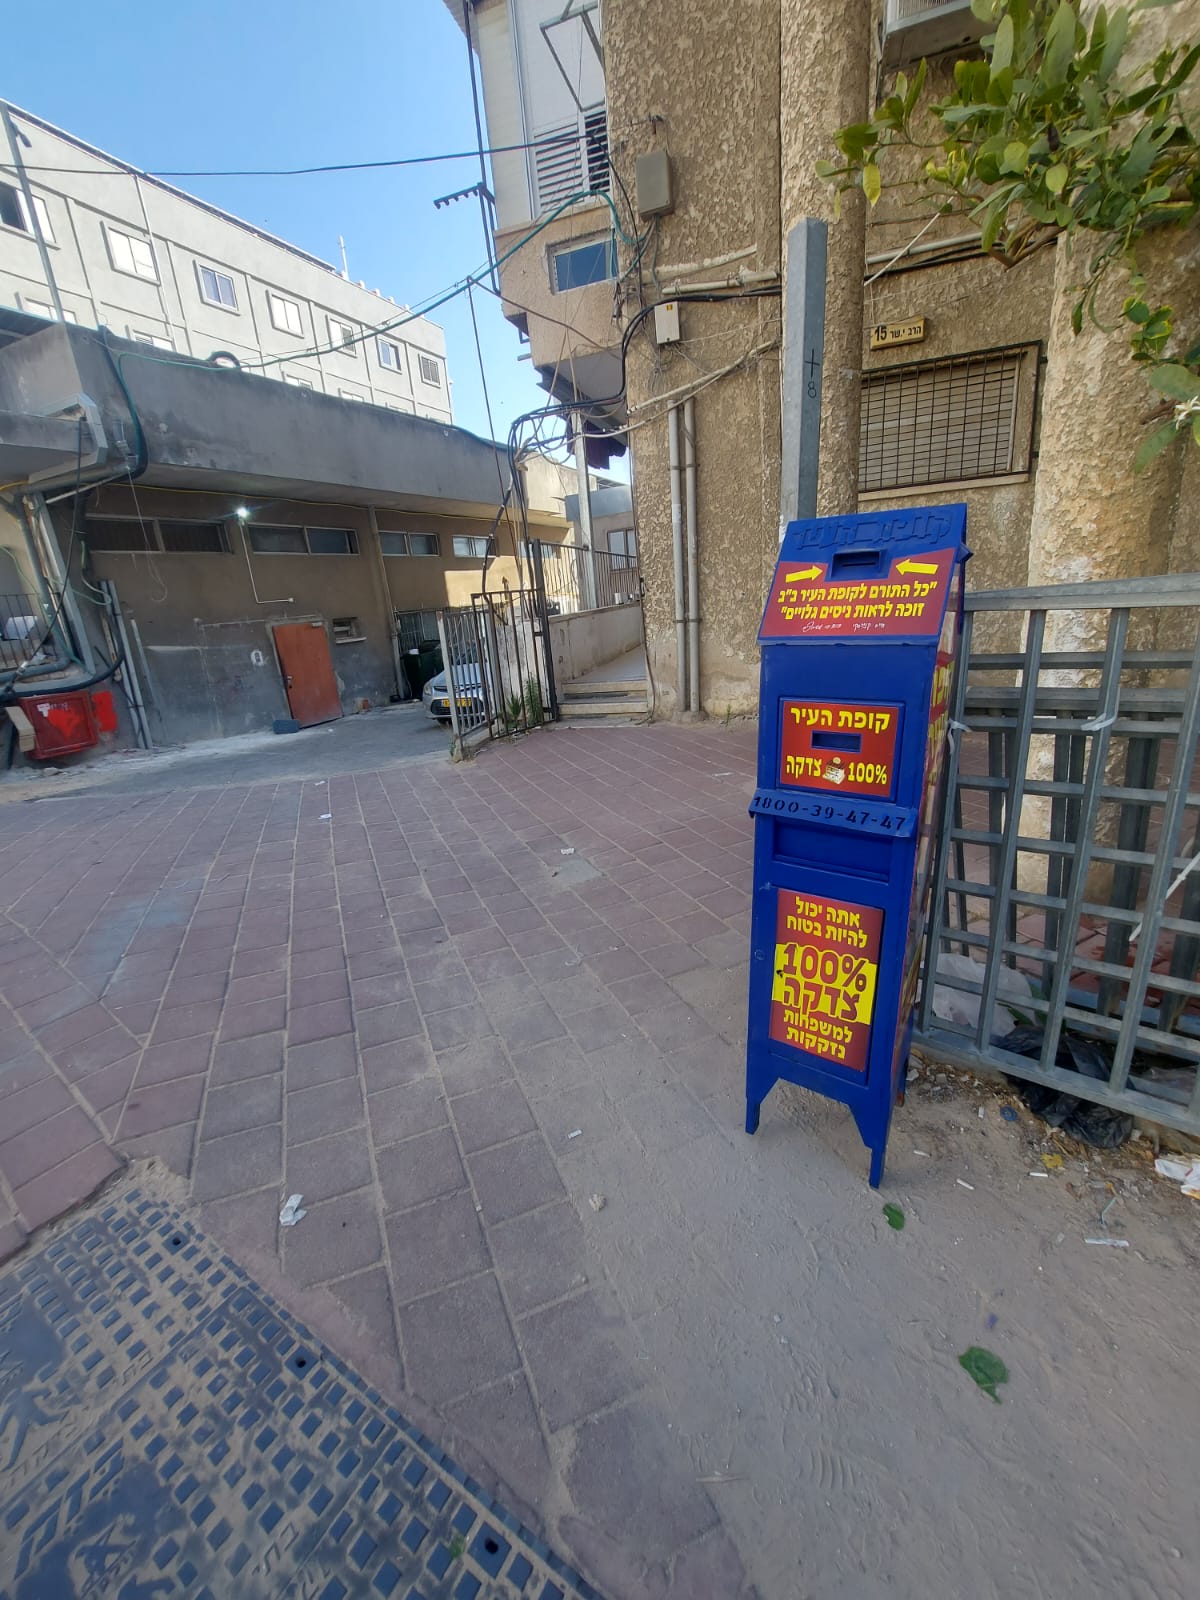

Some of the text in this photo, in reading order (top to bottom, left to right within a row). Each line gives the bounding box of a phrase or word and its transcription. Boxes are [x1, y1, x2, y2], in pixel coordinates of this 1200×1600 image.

[875, 326, 887, 341] 15
[908, 326, 921, 336] הרב
[801, 587, 826, 602] העיר
[827, 583, 866, 604] לקופת
[869, 583, 910, 599] התורם
[819, 605, 852, 619] ניסים
[853, 601, 893, 618] לראות
[895, 603, 925, 617] זוכה
[790, 707, 891, 734] קופת העיר
[786, 755, 822, 780] צדקה
[847, 761, 888, 785] 100%
[753, 796, 906, 831] 1800-39-47-47
[795, 895, 861, 928] אתה יכול
[786, 915, 868, 949] להיות בטוח
[782, 942, 868, 993] 100%
[782, 976, 861, 1022] צדקה
[783, 1008, 853, 1044] למשפחות
[786, 1026, 846, 1060] נזקקות
